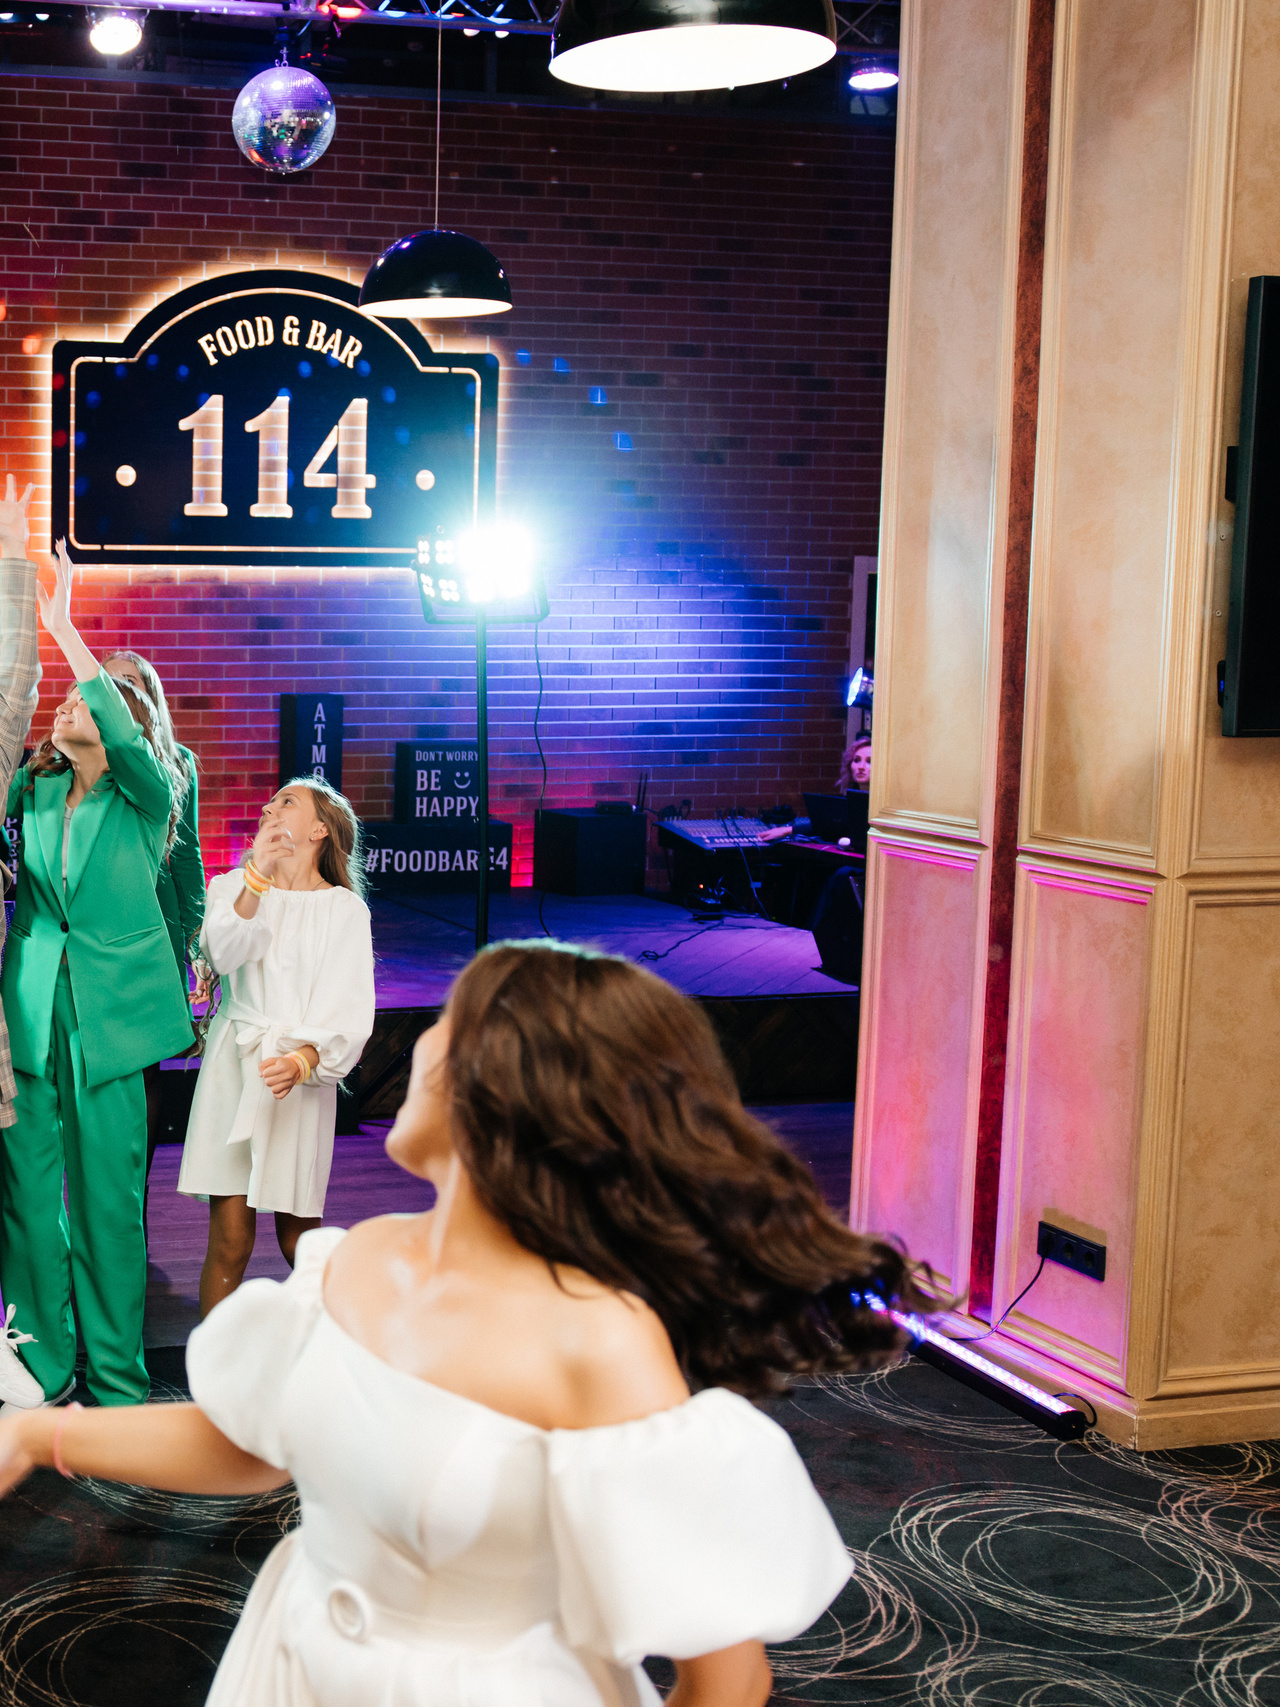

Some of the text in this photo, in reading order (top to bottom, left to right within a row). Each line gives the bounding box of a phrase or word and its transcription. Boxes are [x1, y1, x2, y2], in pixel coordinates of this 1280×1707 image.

[198, 315, 363, 369] FOOD & BAR
[178, 394, 376, 519] 114
[415, 750, 478, 762] DON'T WORRY
[416, 769, 442, 791] BE
[415, 795, 479, 818] HAPPY
